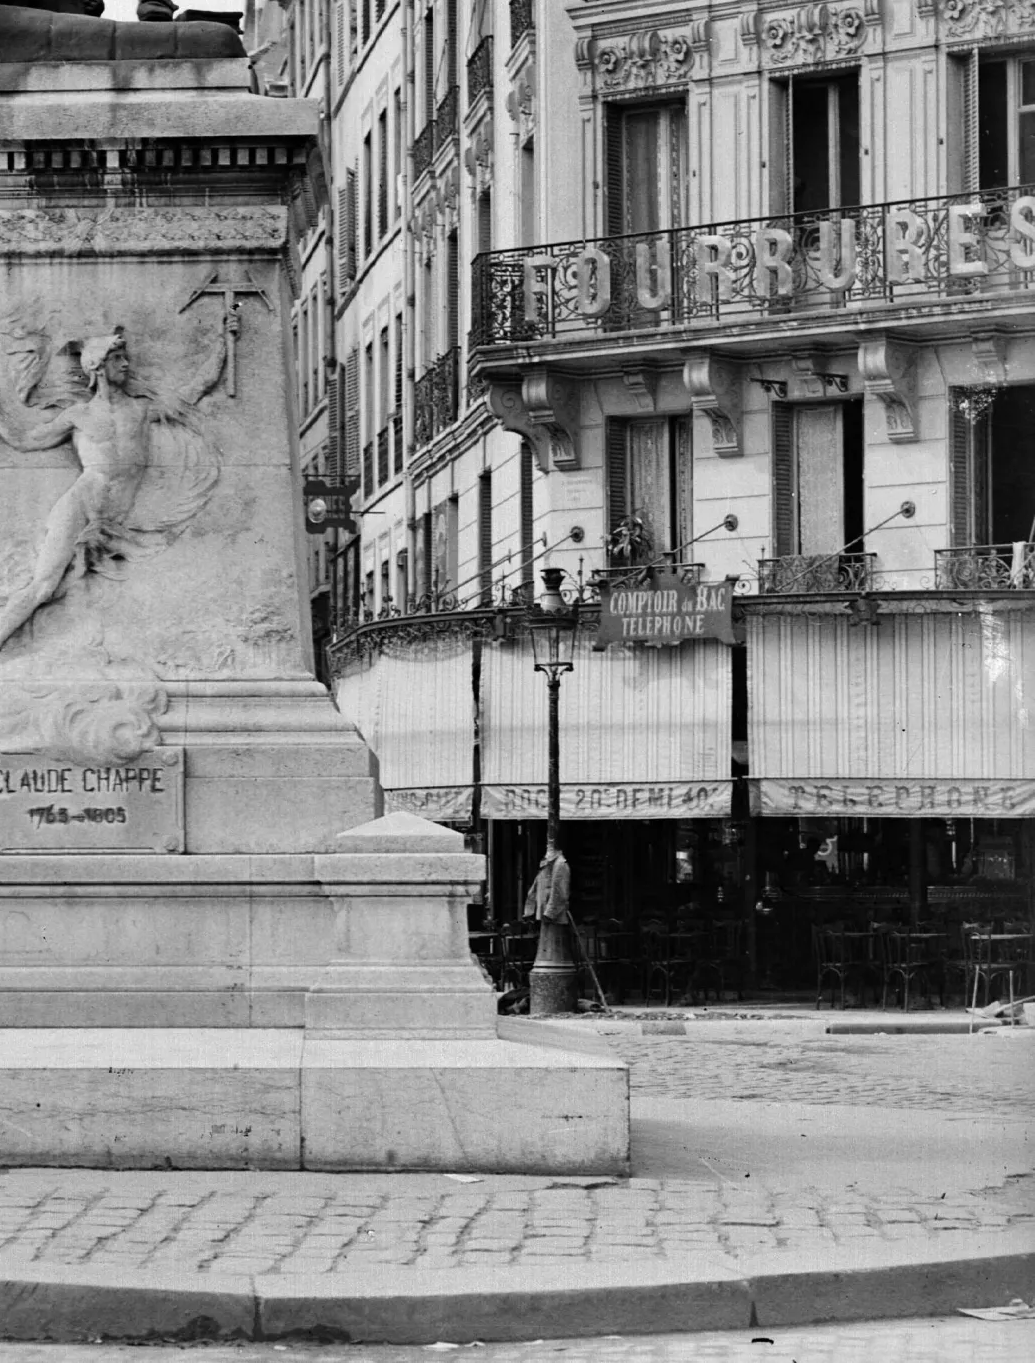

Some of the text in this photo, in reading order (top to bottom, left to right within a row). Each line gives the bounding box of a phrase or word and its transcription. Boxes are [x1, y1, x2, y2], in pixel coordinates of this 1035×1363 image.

[522, 195, 1035, 324] FOURRURES
[610, 589, 678, 615] COMPTOIR
[695, 585, 726, 613] BAC
[621, 614, 706, 637] TELEPHONE
[82, 766, 165, 793] CHAPPE
[788, 784, 1016, 812] TELEPHONE
